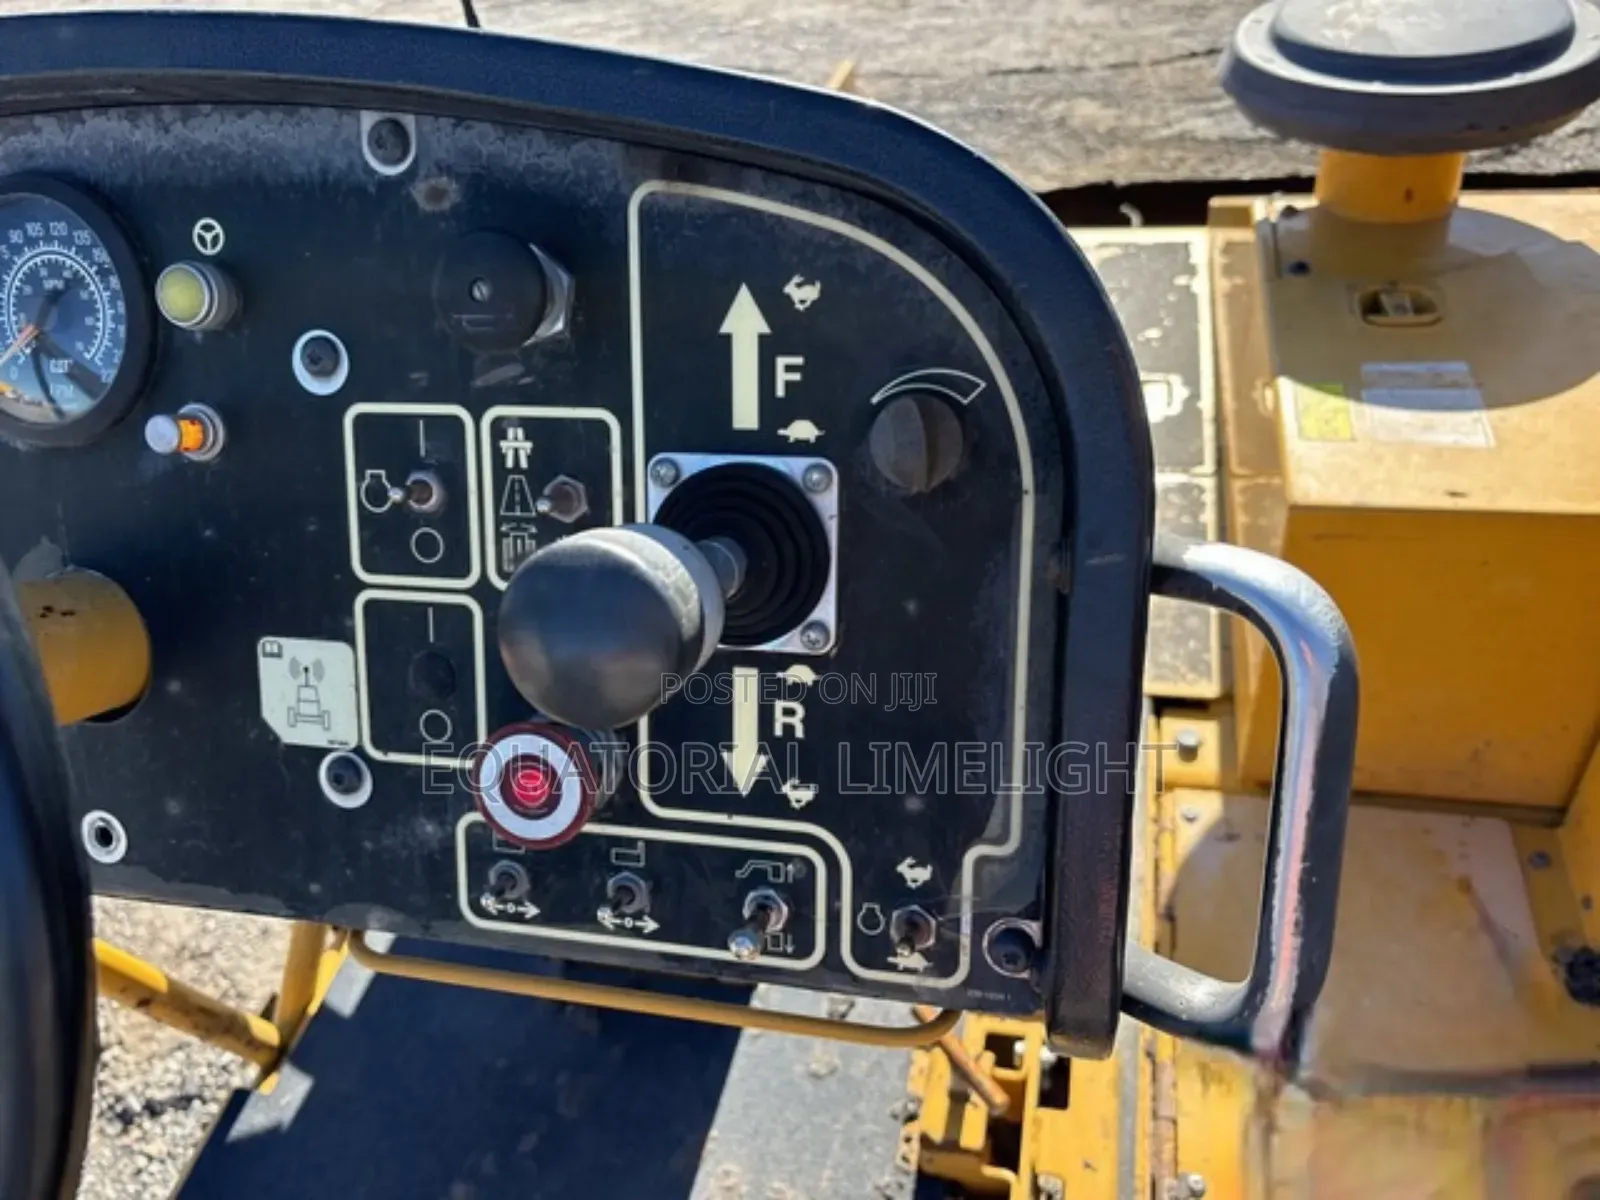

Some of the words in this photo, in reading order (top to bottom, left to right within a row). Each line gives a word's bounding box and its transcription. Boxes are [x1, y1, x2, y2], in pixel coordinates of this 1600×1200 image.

[7, 229, 24, 244] 90
[24, 221, 45, 237] 105
[48, 220, 68, 236] 120
[72, 229, 92, 246] 135
[774, 354, 805, 399] F
[774, 700, 806, 739] R
